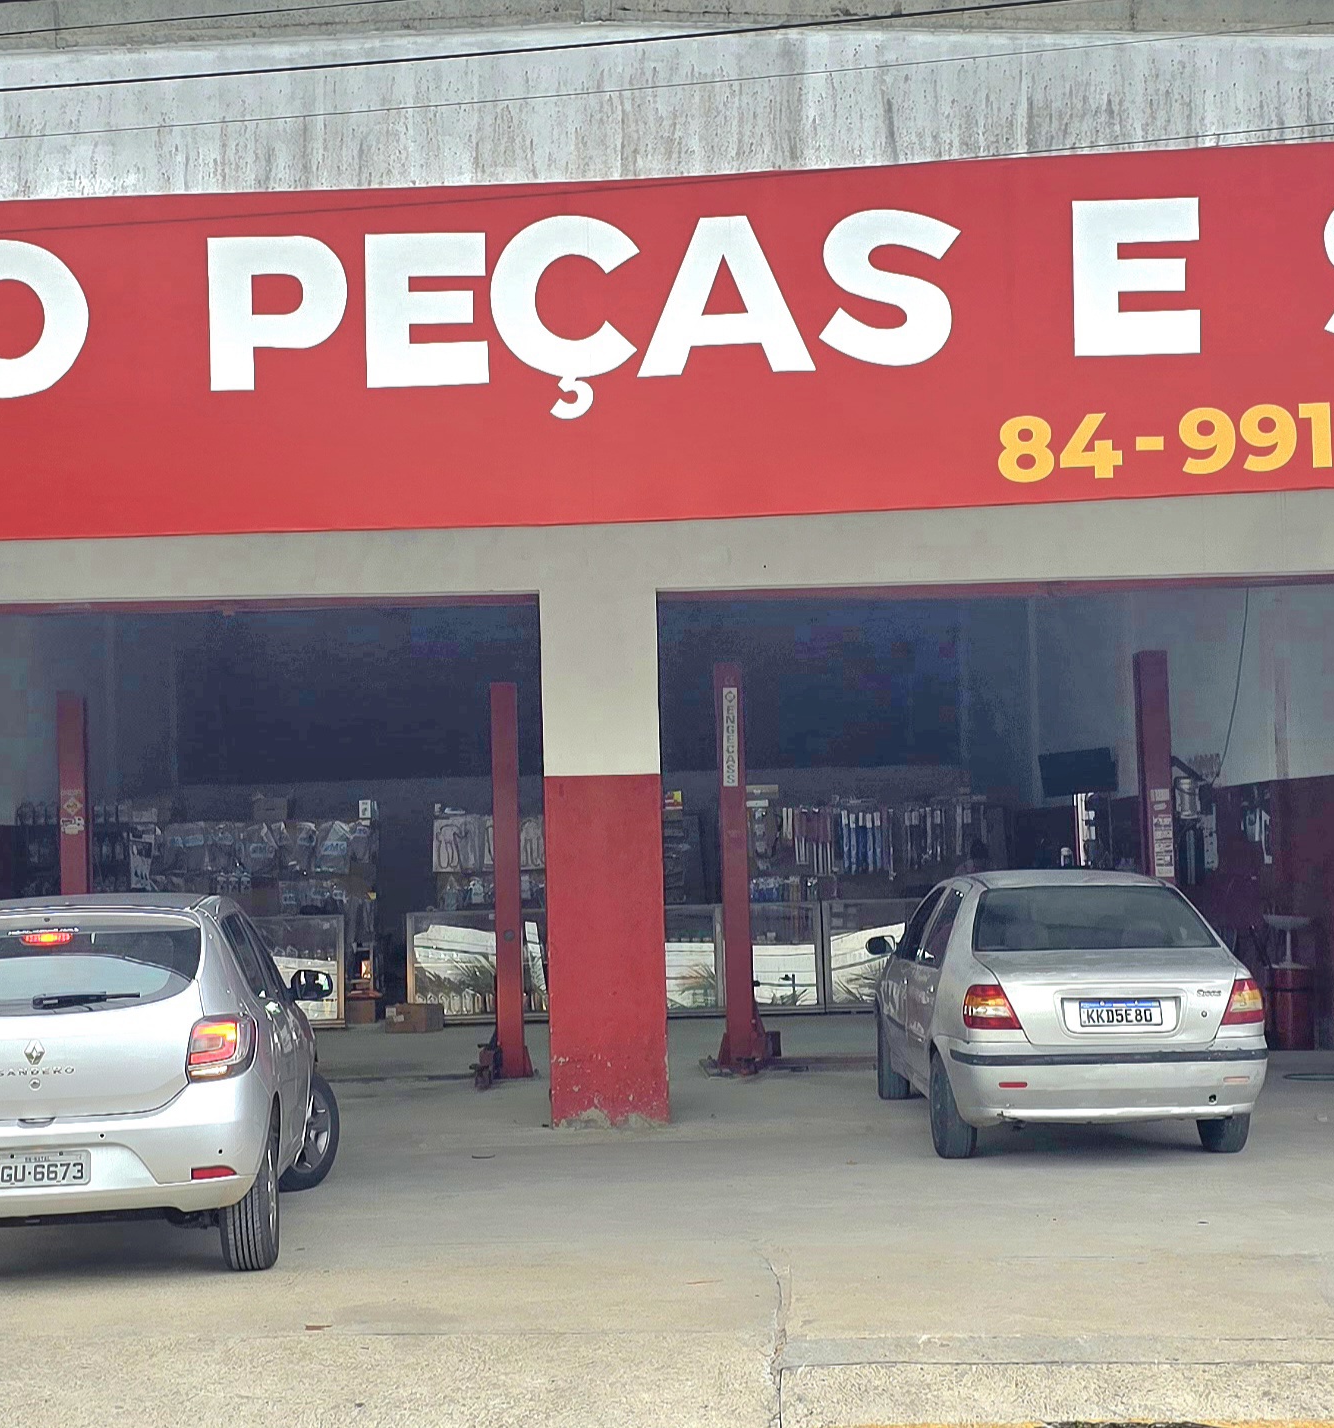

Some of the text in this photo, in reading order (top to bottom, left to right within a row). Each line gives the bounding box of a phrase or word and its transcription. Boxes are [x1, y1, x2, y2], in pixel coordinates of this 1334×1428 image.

[207, 208, 961, 420] PEÇAS
[1072, 197, 1200, 356] E
[726, 706, 736, 784] ENGECASS
[1086, 1009, 1153, 1024] KKD5E80
